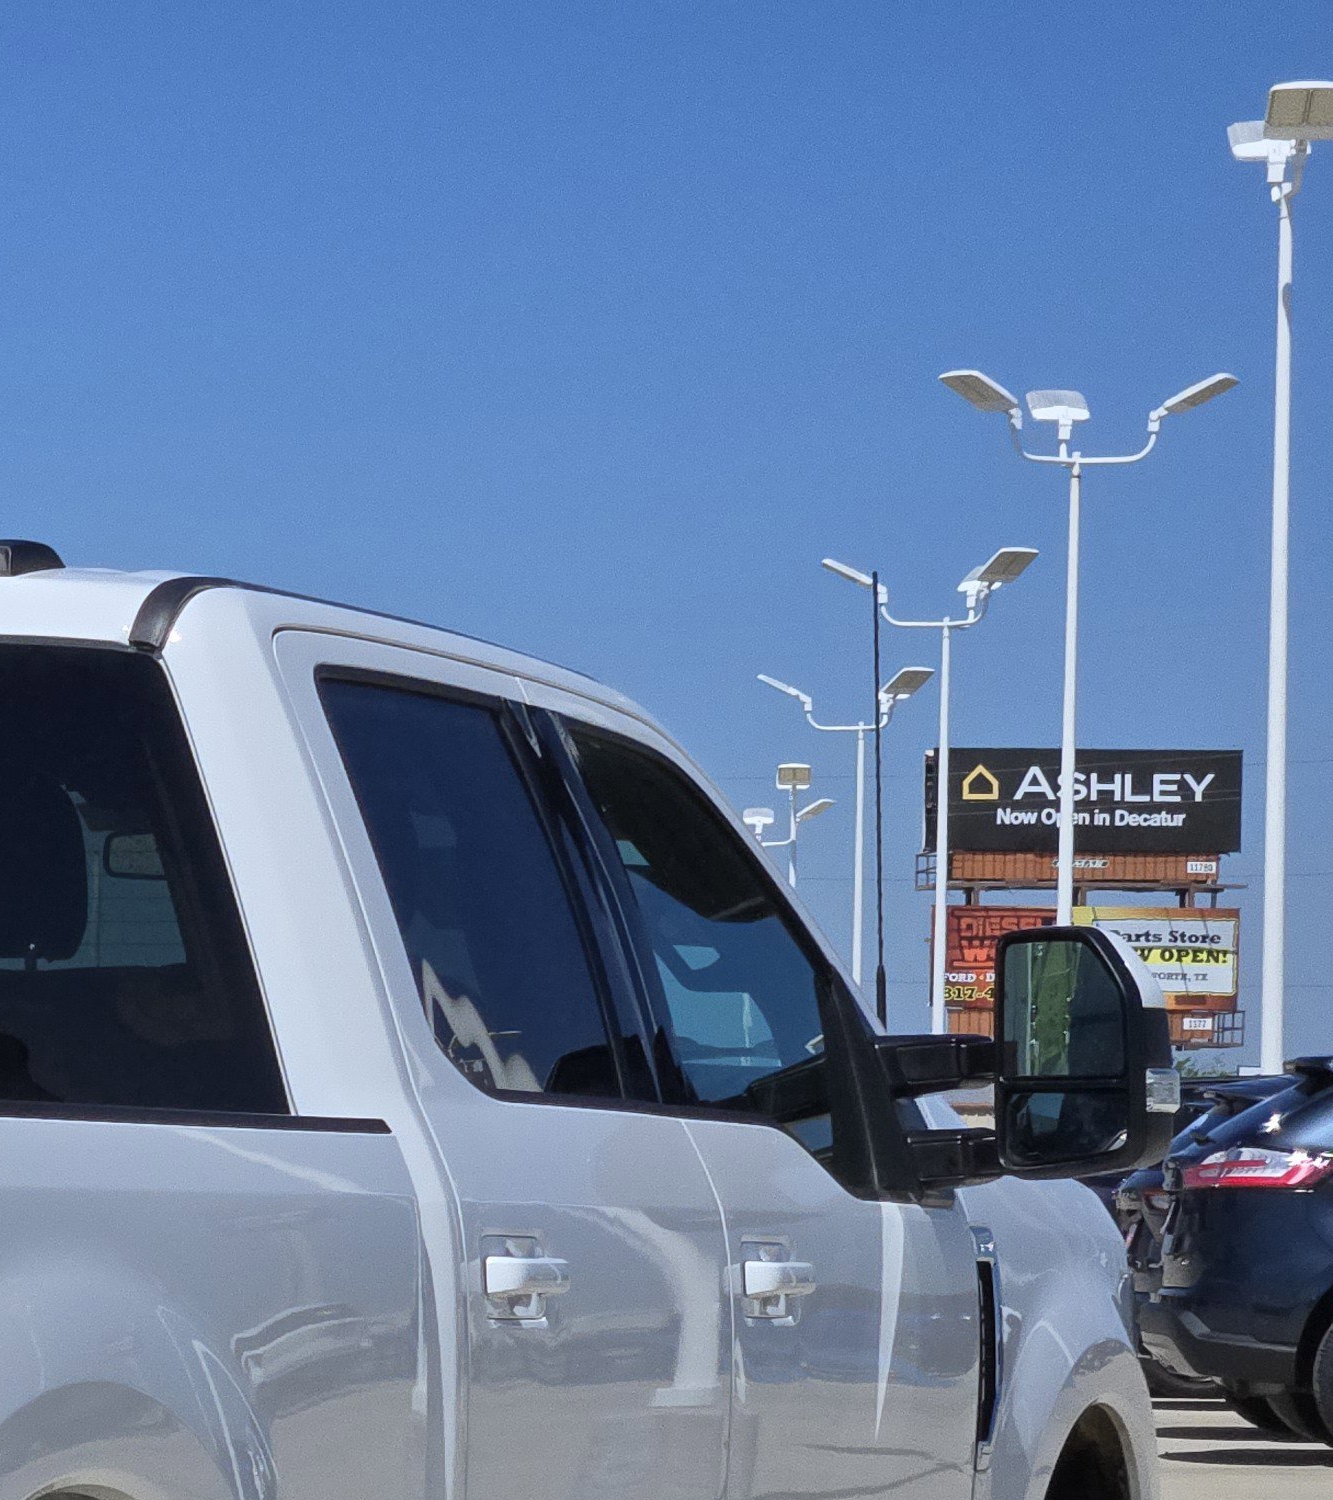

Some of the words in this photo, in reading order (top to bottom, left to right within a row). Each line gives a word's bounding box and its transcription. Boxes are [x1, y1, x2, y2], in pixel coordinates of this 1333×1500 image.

[1013, 766, 1215, 803] ASHLEY
[996, 808, 1037, 826] Now
[1094, 809, 1110, 826] in
[1114, 810, 1186, 827] Decatur
[1168, 930, 1221, 944] Store
[1159, 949, 1229, 963] OPEN!
